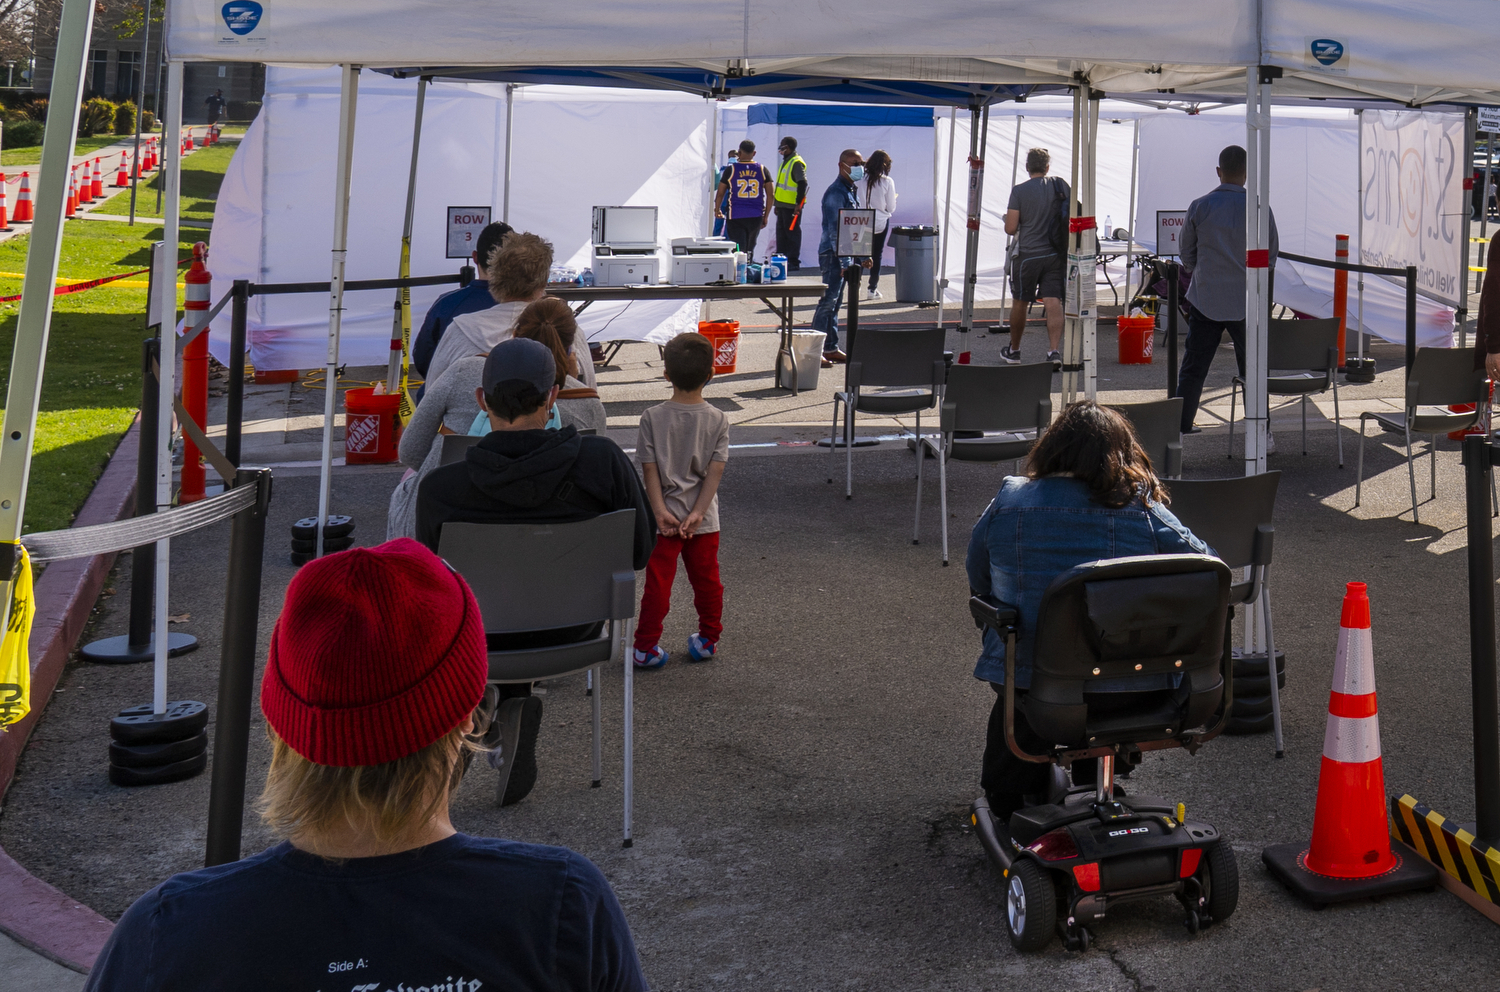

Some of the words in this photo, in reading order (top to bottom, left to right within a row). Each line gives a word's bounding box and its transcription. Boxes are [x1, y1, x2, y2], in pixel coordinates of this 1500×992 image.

[739, 170, 757, 178] JAMES
[737, 179, 760, 198] 23
[454, 215, 484, 224] ROW
[844, 216, 869, 225] ROW
[1162, 218, 1184, 226] ROW
[465, 232, 472, 241] 3
[852, 232, 859, 241] 2
[1170, 233, 1176, 241] 1
[346, 415, 379, 452] HOME
[328, 960, 354, 973] Side
[355, 958, 369, 969] A:
